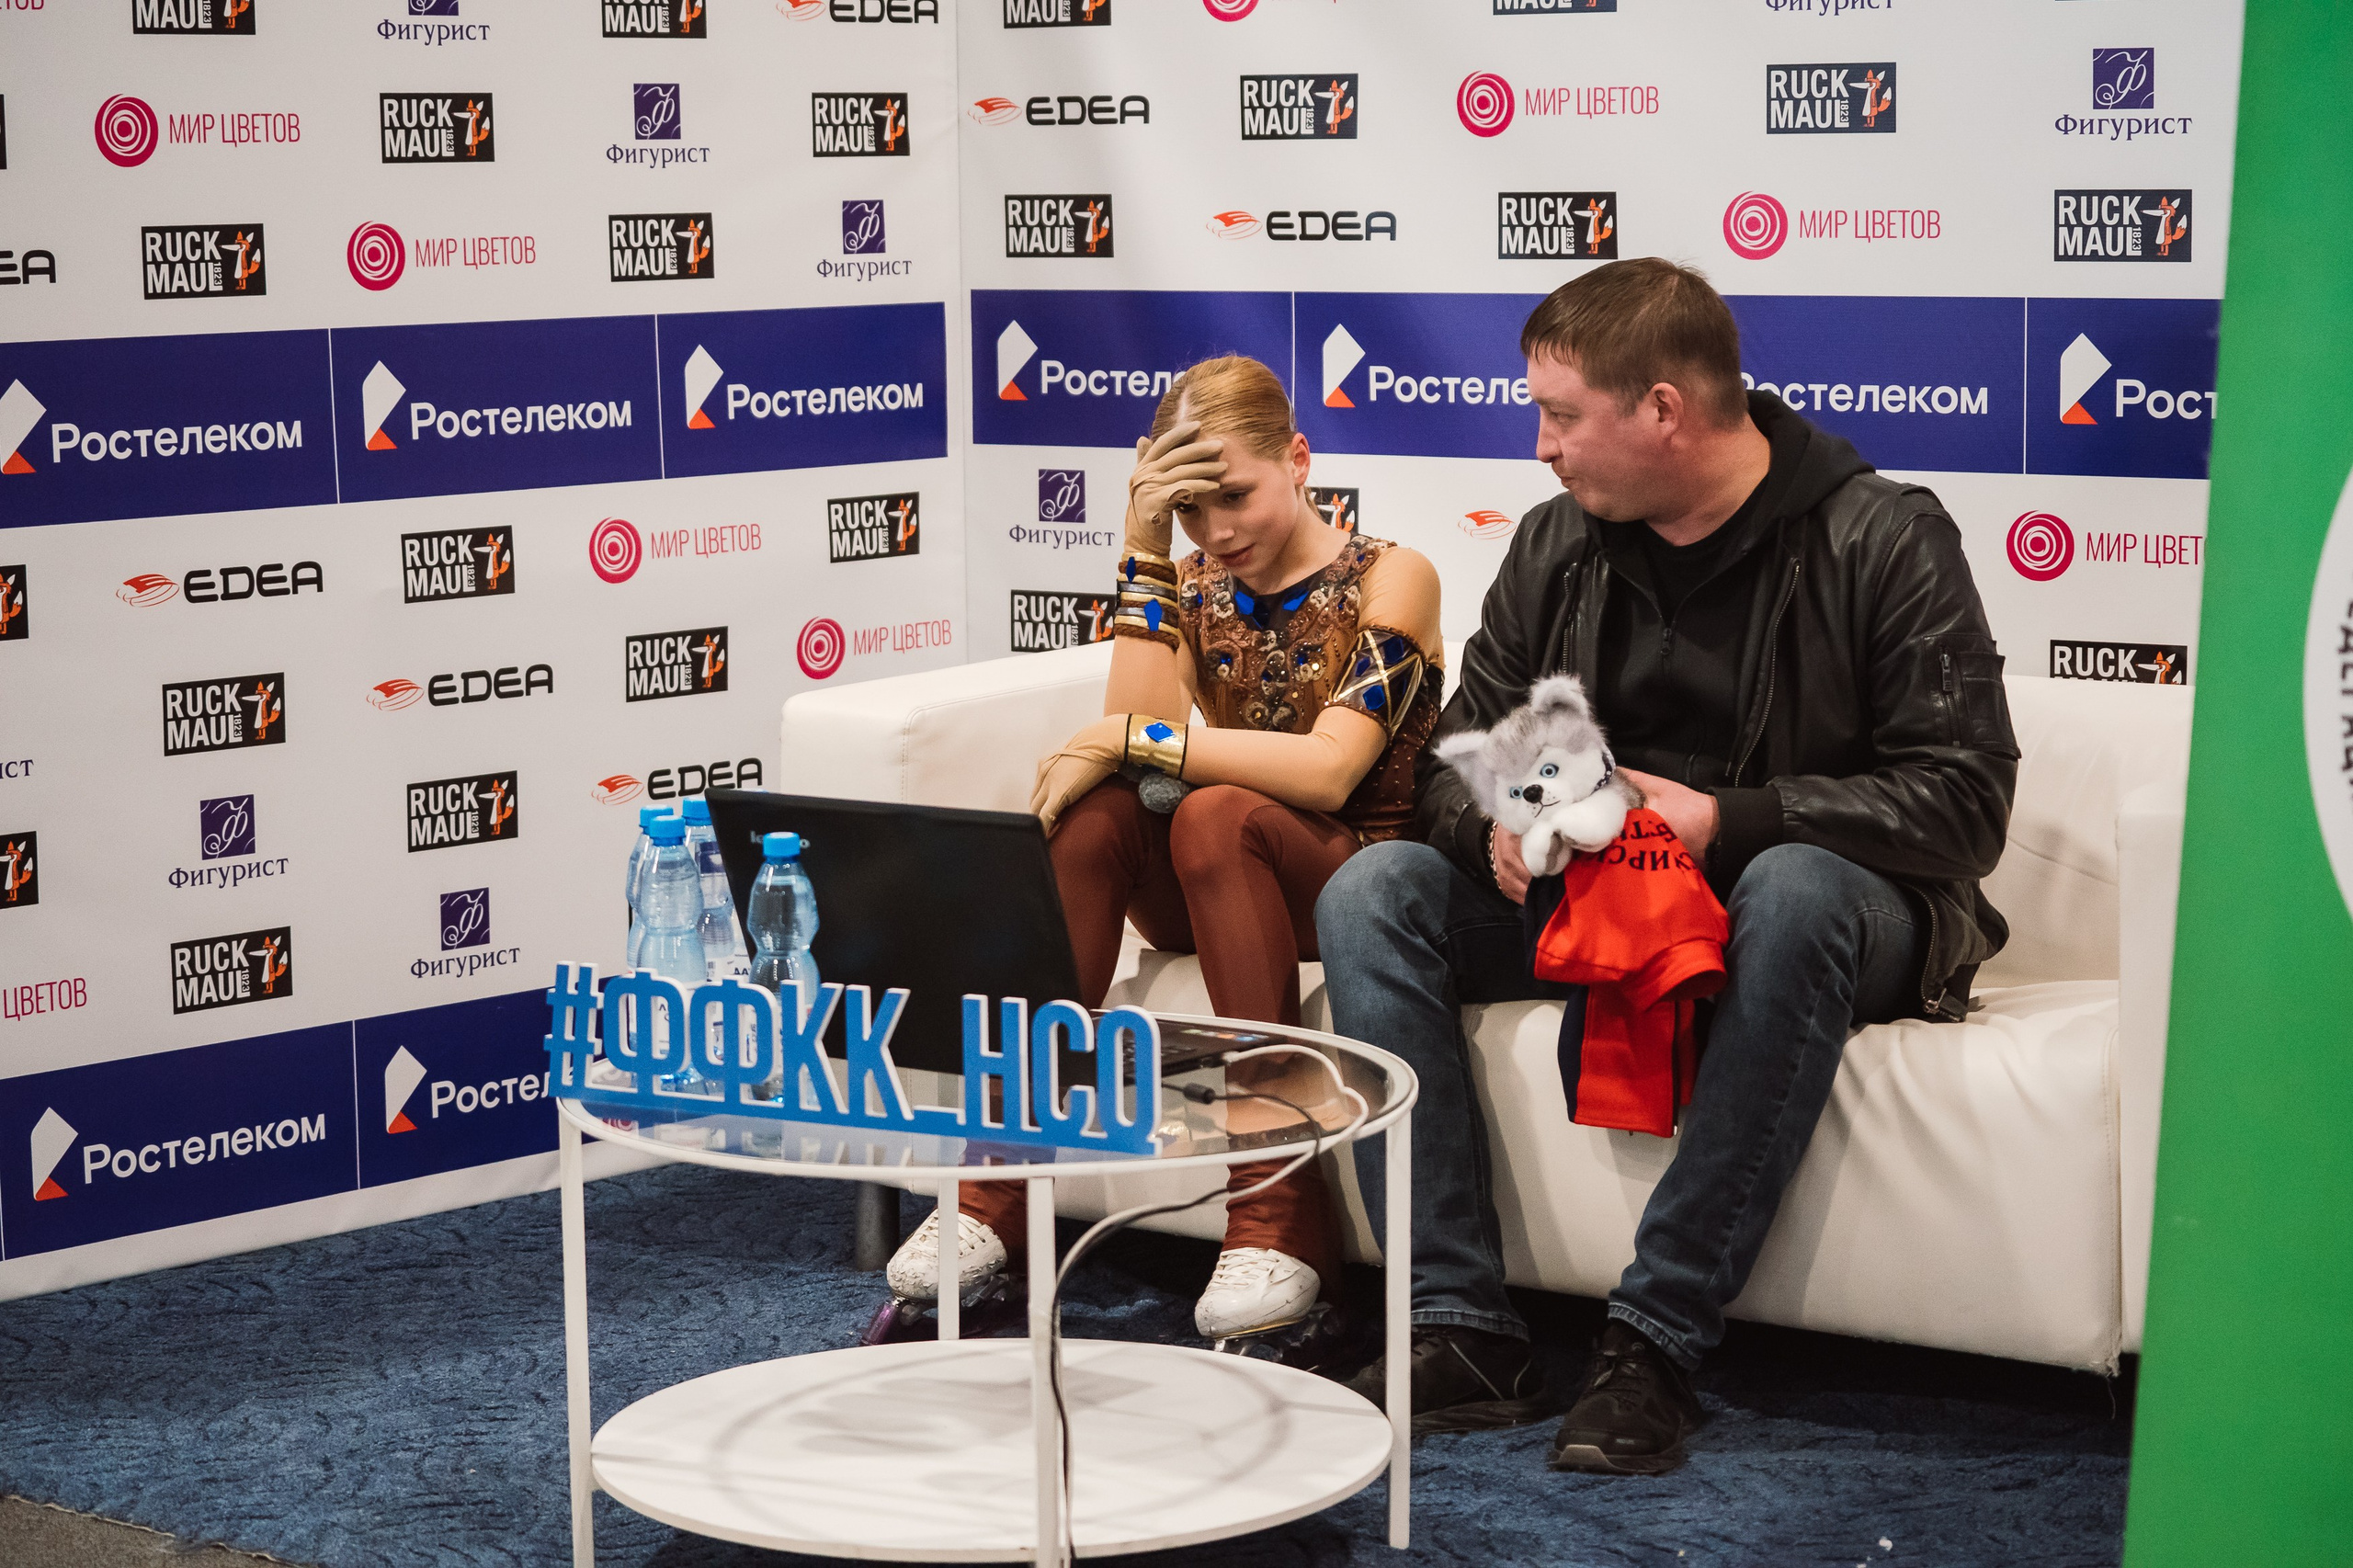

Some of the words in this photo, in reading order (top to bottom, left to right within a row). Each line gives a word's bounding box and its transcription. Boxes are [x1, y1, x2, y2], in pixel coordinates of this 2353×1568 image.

[136, 0, 212, 28] MAUL
[203, 0, 211, 23] 1823
[605, 5, 670, 33] MAUL
[662, 6, 670, 28] 1823
[829, 0, 938, 24] EDEA
[1006, 0, 1071, 24] MAUL
[377, 19, 490, 46] Фигурист
[1244, 79, 1314, 107] RUCK
[1770, 69, 1849, 98] RUCK
[383, 98, 454, 128] RUCK
[814, 97, 874, 125] RUCK
[1026, 96, 1149, 126] EDEA
[1526, 87, 1570, 116] МИР
[1577, 86, 1659, 119] ЦВЕТОВ
[1770, 99, 1849, 129] MAUL
[1840, 99, 1849, 122] 1823
[169, 114, 215, 143] МИР
[221, 113, 301, 147] ЦВЕТОВ
[1245, 108, 1314, 135] MAUL
[1306, 108, 1314, 130] 1823
[2055, 114, 2192, 141] Фигурист
[384, 129, 455, 157] MAUL
[446, 129, 455, 152] 1823
[815, 125, 876, 153] MAUL
[607, 144, 710, 169] Фигурист
[1007, 199, 1074, 226] RUCK
[1502, 198, 1574, 225] RUCK
[2058, 195, 2143, 225] RUCK
[612, 219, 676, 247] RUCK
[1008, 227, 1074, 253] MAUL
[1066, 227, 1074, 248] 1823
[1267, 210, 1396, 241] EDEA
[1502, 226, 1574, 255] MAUL
[1566, 227, 1574, 249] 1823
[1800, 210, 1847, 238] МИР
[1855, 210, 1940, 243] ЦВЕТОВ
[2132, 227, 2142, 251] 1823
[145, 231, 222, 262] RUCK
[415, 238, 458, 267] МИР
[463, 236, 536, 269] ЦВЕТОВ
[2058, 226, 2143, 256] MAUL
[613, 247, 678, 277] MAUL
[670, 247, 678, 269] 1823
[817, 259, 912, 282] Фигурист
[147, 262, 223, 293] MAUL
[213, 262, 222, 286] 1823
[1041, 359, 1187, 397] Ростел
[727, 382, 923, 420] Ростелеком
[411, 401, 631, 440] Ростелеком
[51, 420, 302, 463] Ростелеком
[830, 500, 889, 530] RUCK
[404, 534, 474, 567] RUCK
[651, 529, 689, 559] МИР
[695, 523, 761, 559] ЦВЕТОВ
[832, 527, 889, 558] MAUL
[1009, 525, 1115, 550] Фигурист
[2086, 532, 2137, 562] МИР
[184, 561, 324, 604] EDEA
[407, 563, 476, 597] MAUL
[467, 563, 475, 587] 1823
[1014, 595, 1079, 623] RUCK
[854, 627, 889, 655] МИР
[892, 619, 951, 654] ЦВЕТОВ
[1014, 621, 1078, 649] MAUL
[629, 635, 692, 668] RUCK
[2054, 645, 2137, 678] RUCK
[427, 664, 553, 707] EDEA
[629, 664, 692, 697] MAUL
[166, 683, 242, 719] RUCK
[167, 713, 243, 750] MAUL
[647, 757, 763, 801] EDEA
[411, 781, 479, 817] RUCK
[411, 811, 480, 846] MAUL
[168, 858, 289, 889] Фигурист
[175, 938, 249, 977] RUCK
[411, 948, 520, 979] Фигурист
[176, 969, 250, 1007] MAUL
[242, 969, 250, 993] 1823
[4, 978, 87, 1021] ЦВЕТОВ
[84, 1113, 325, 1184] Ростелеком
